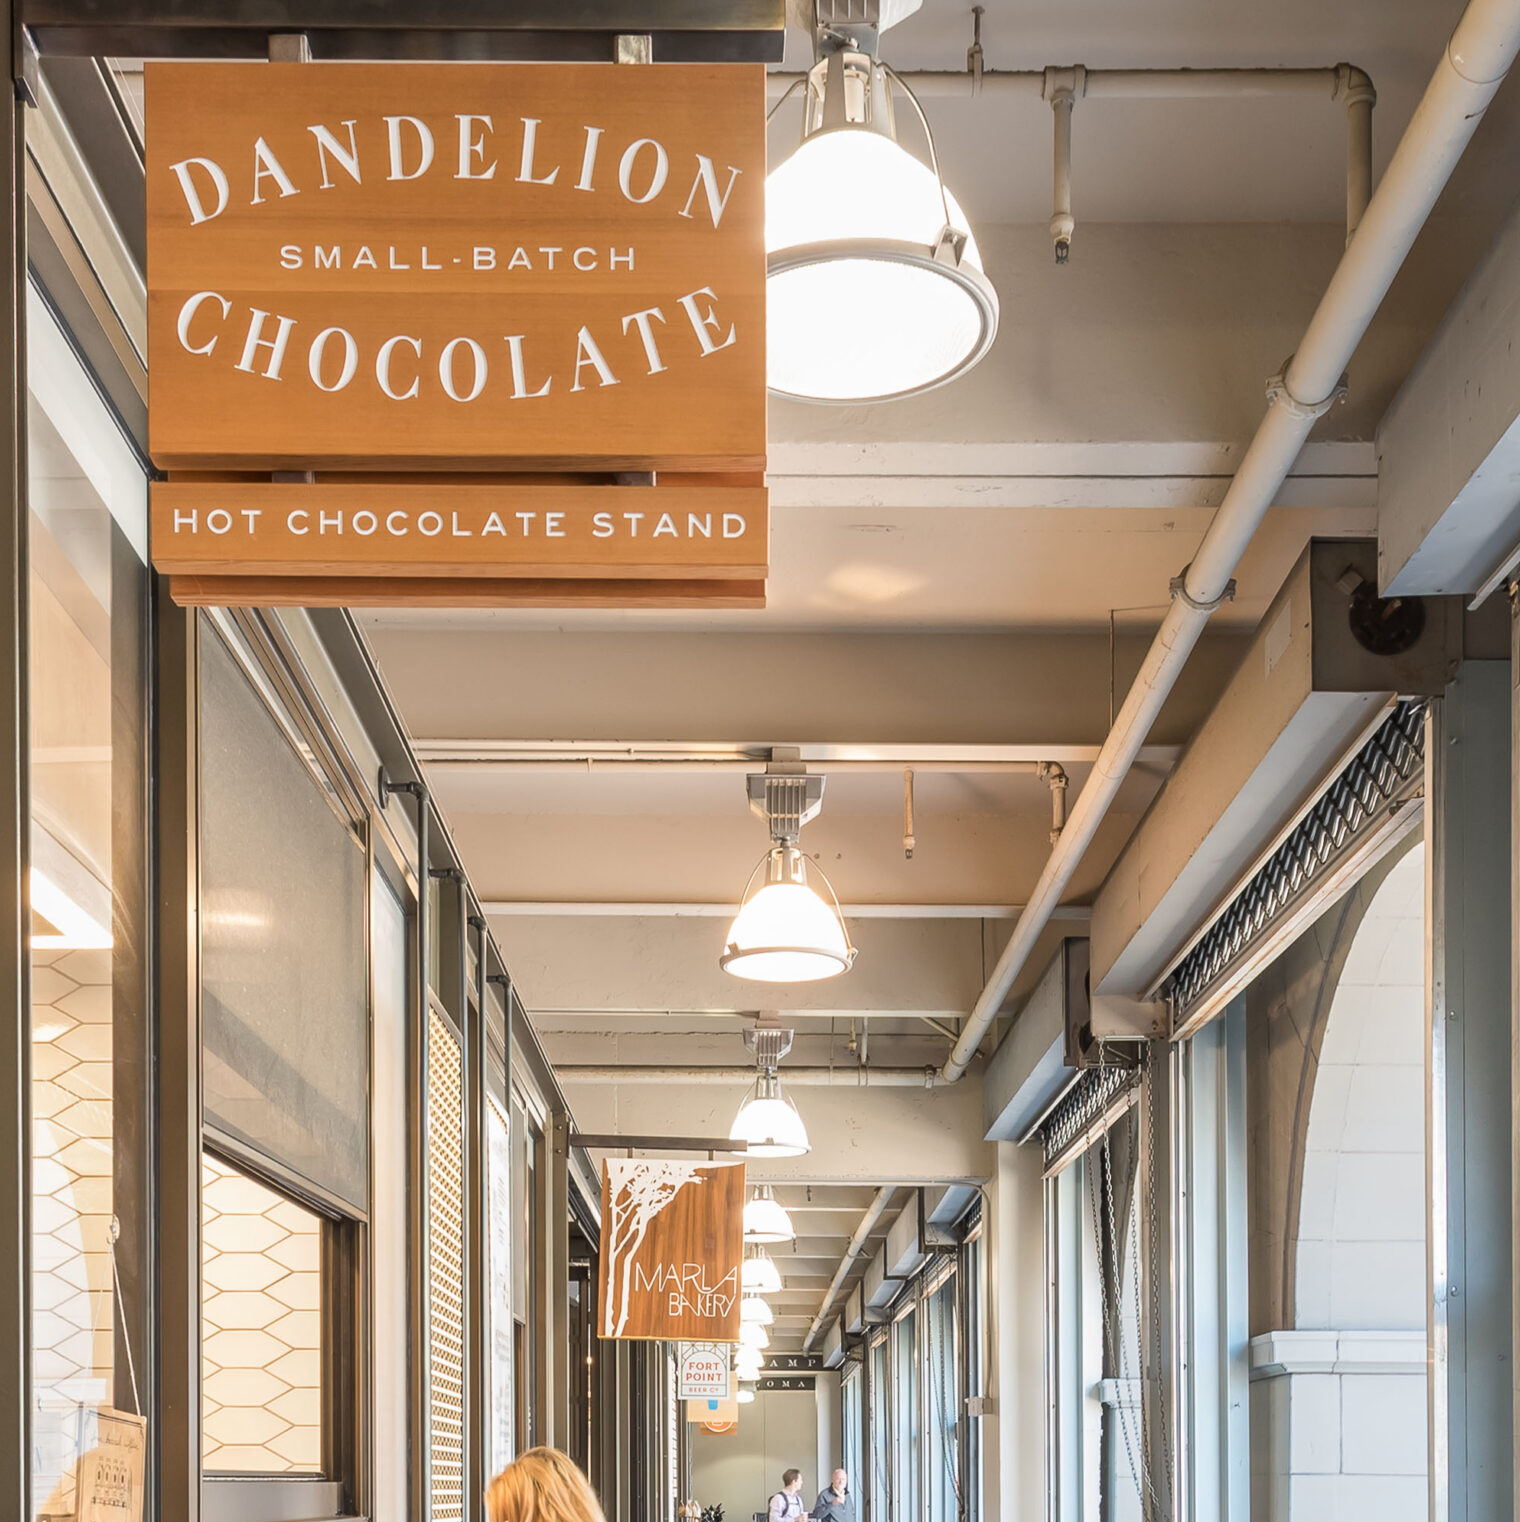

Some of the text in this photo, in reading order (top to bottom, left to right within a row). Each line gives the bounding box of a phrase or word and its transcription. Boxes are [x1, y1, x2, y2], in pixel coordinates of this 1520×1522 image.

[169, 115, 742, 228] DANDELION
[280, 245, 634, 271] SMALL-BATCH
[178, 286, 736, 402] CHOCOLATE
[174, 509, 745, 538] HOT CHOCOLATE STAND
[635, 1262, 737, 1294] MARLA
[668, 1292, 736, 1317] BAKERY
[686, 1372, 723, 1381] POINT
[688, 1361, 720, 1371] FORT
